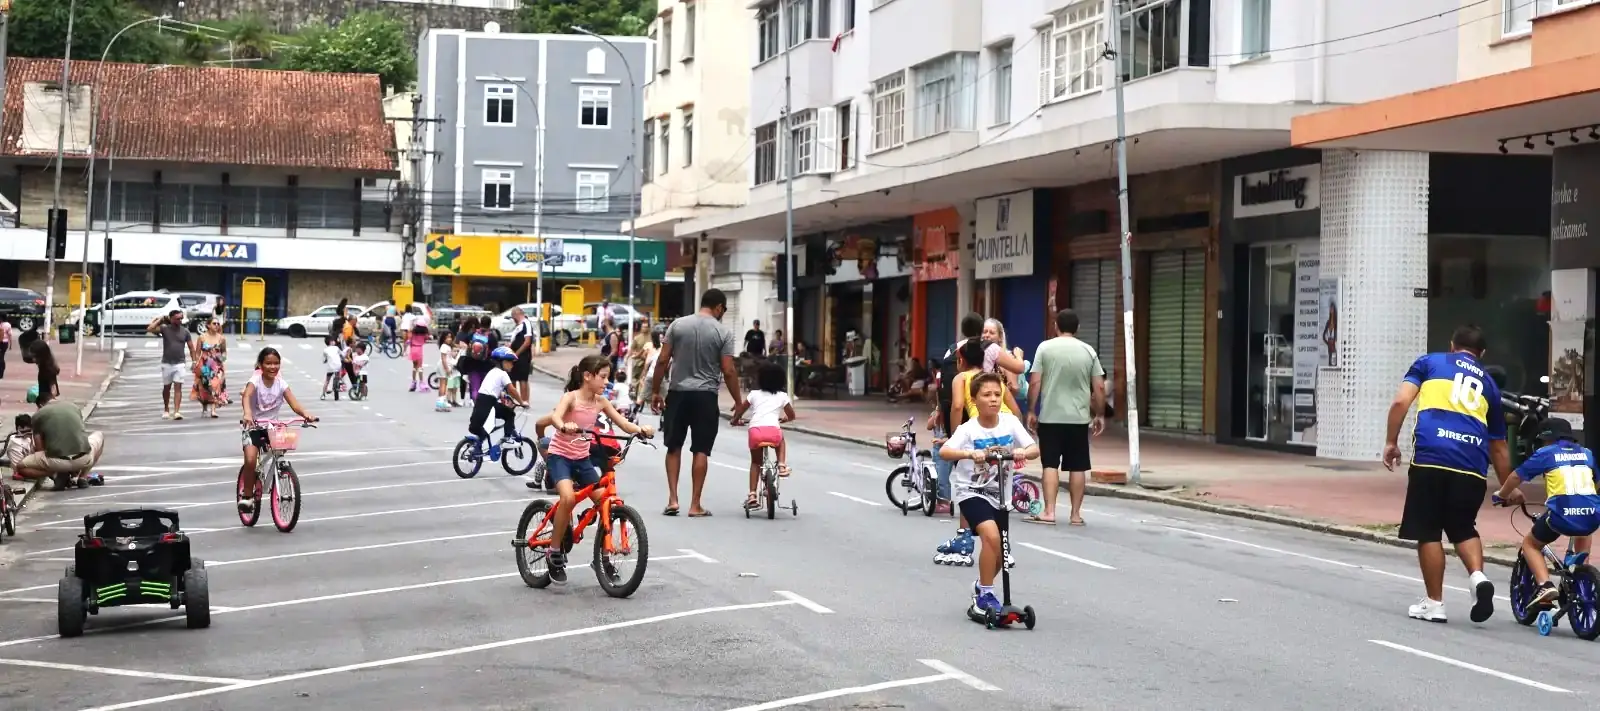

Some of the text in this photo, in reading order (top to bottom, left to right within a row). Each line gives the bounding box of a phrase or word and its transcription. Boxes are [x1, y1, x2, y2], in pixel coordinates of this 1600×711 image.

[189, 243, 248, 258] CAIXA
[976, 232, 1029, 261] QUINTELLA
[1456, 360, 1484, 378] CAVANI
[1449, 372, 1483, 410] 10
[1437, 428, 1482, 446] DIRECTV
[1559, 465, 1595, 495] 10
[1563, 507, 1595, 516] DIRECTV
